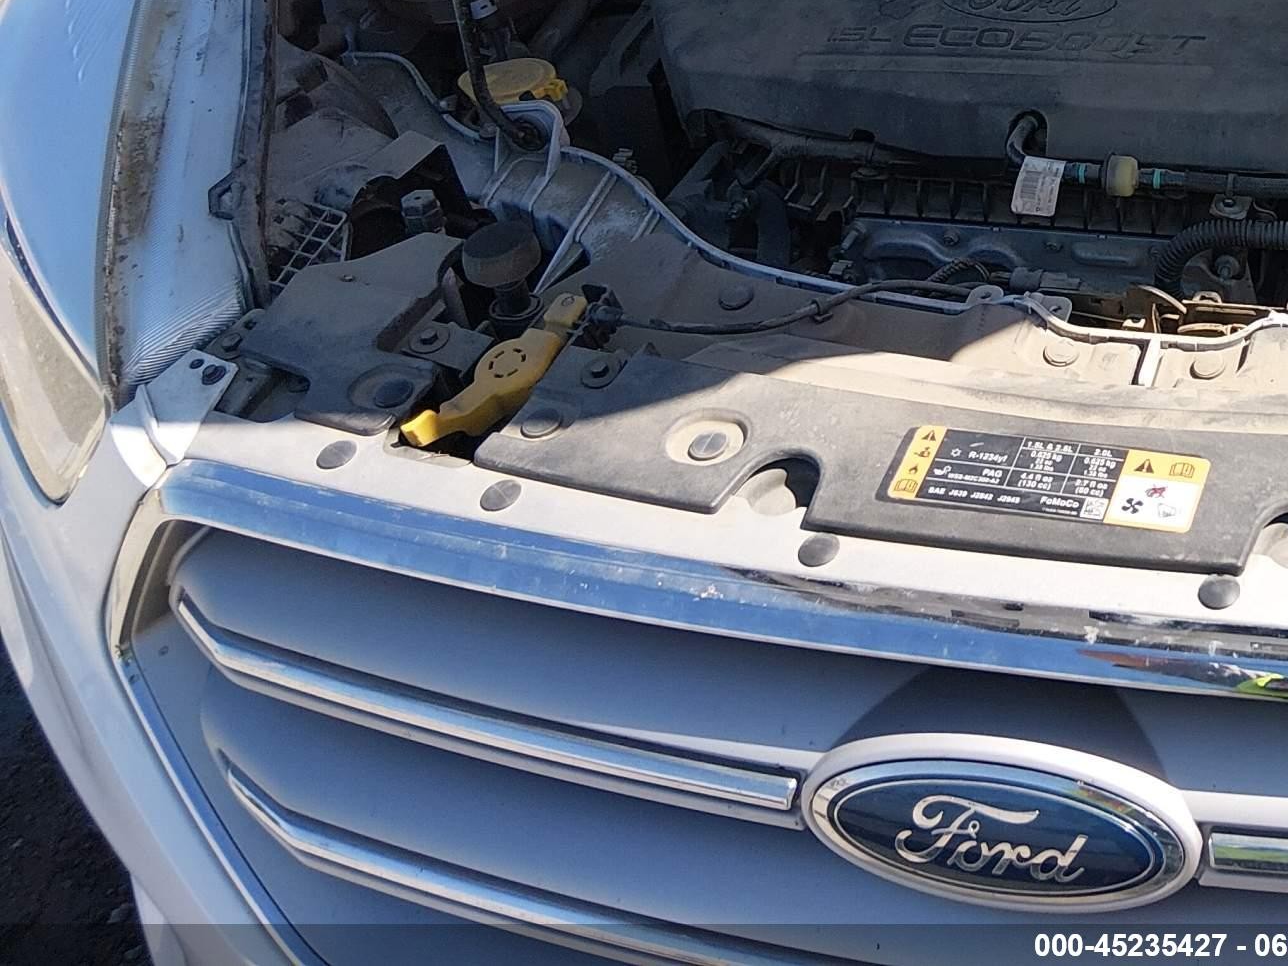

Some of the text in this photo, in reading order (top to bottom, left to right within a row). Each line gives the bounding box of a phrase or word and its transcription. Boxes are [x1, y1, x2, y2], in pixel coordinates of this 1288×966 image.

[903, 24, 1207, 59] ECOBOOST
[968, 451, 1008, 463] R-1234yf
[1052, 453, 1062, 462] kg
[1106, 459, 1116, 469] kg
[1018, 480, 1051, 490] (130 cc)
[1040, 496, 1079, 508] FoMoCo
[896, 794, 1088, 882] Ford
